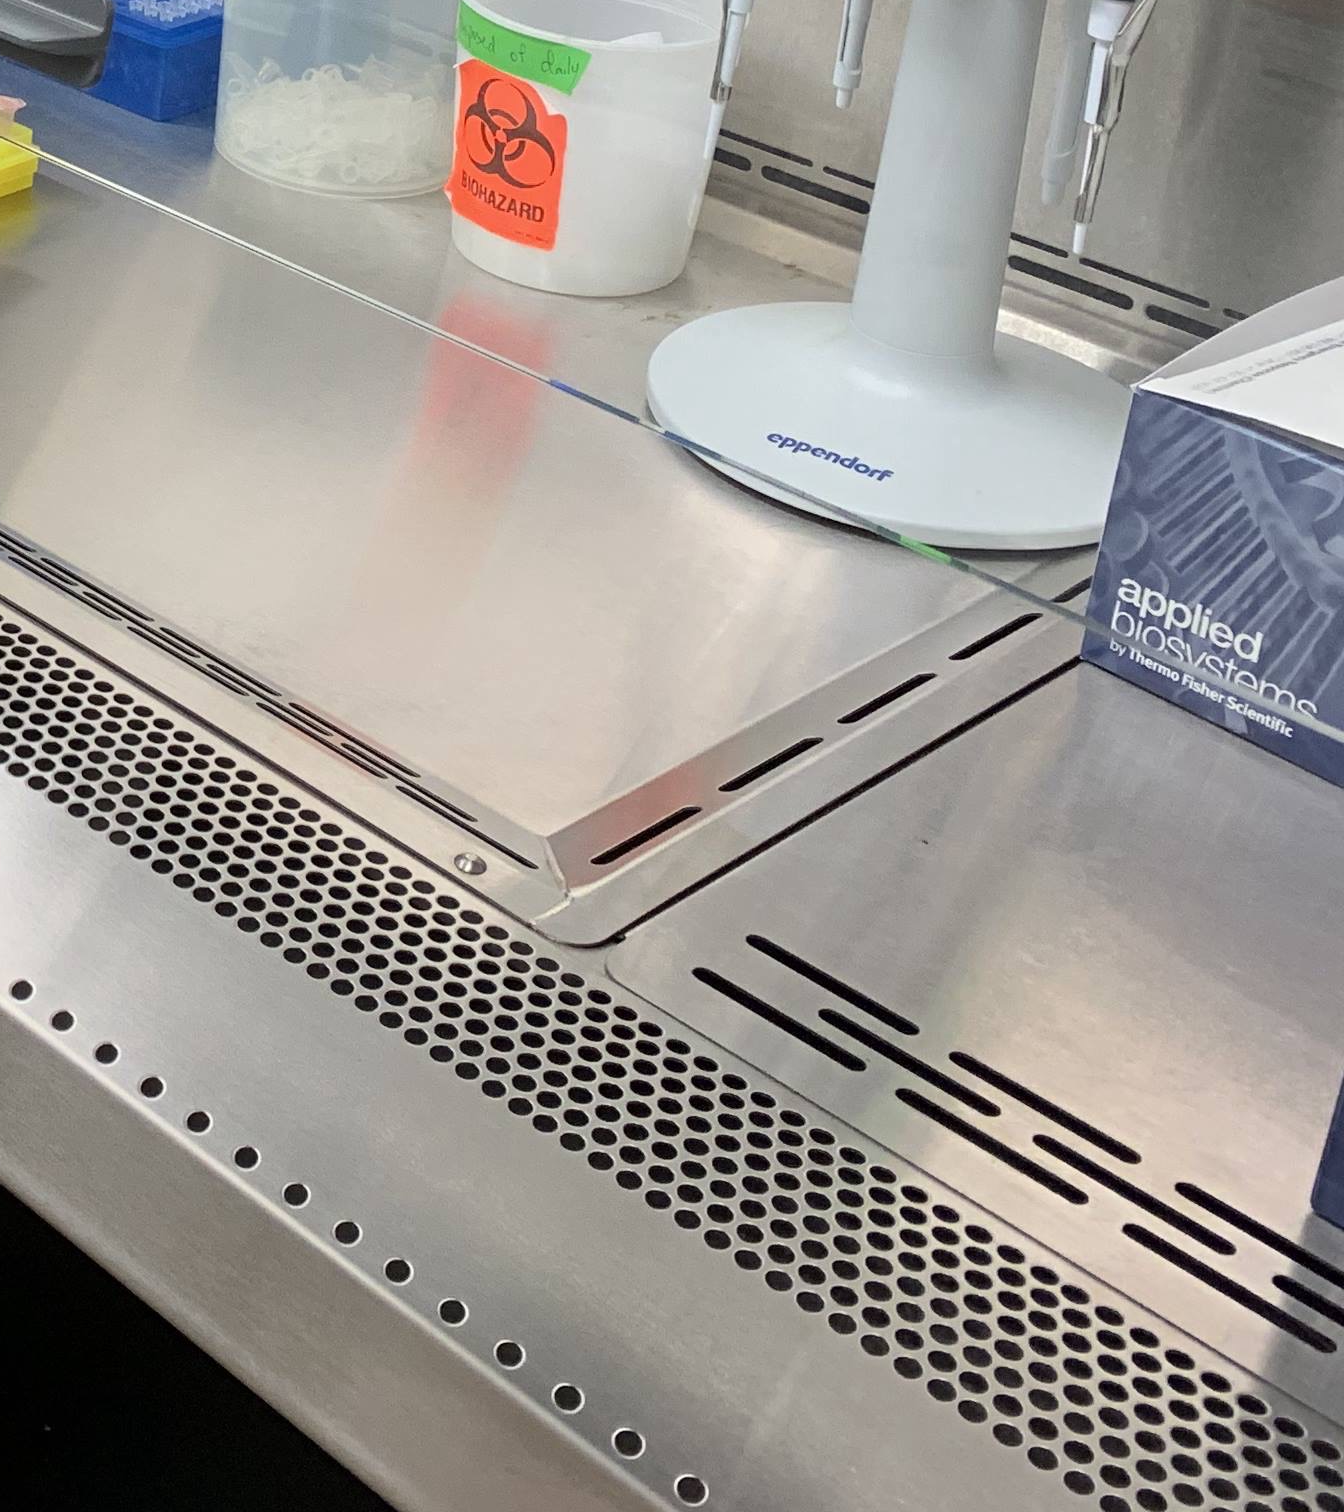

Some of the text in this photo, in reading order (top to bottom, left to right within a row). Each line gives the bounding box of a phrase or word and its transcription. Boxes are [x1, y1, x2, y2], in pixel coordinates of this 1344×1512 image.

[509, 43, 526, 63] of
[541, 49, 580, 76] daily
[461, 169, 545, 223] BIOHAZARD
[767, 433, 894, 482] eppendorf
[1117, 577, 1265, 664] applied
[1109, 637, 1294, 739] by Thermo Fisher Scientific
[1110, 599, 1319, 724] biosystems
